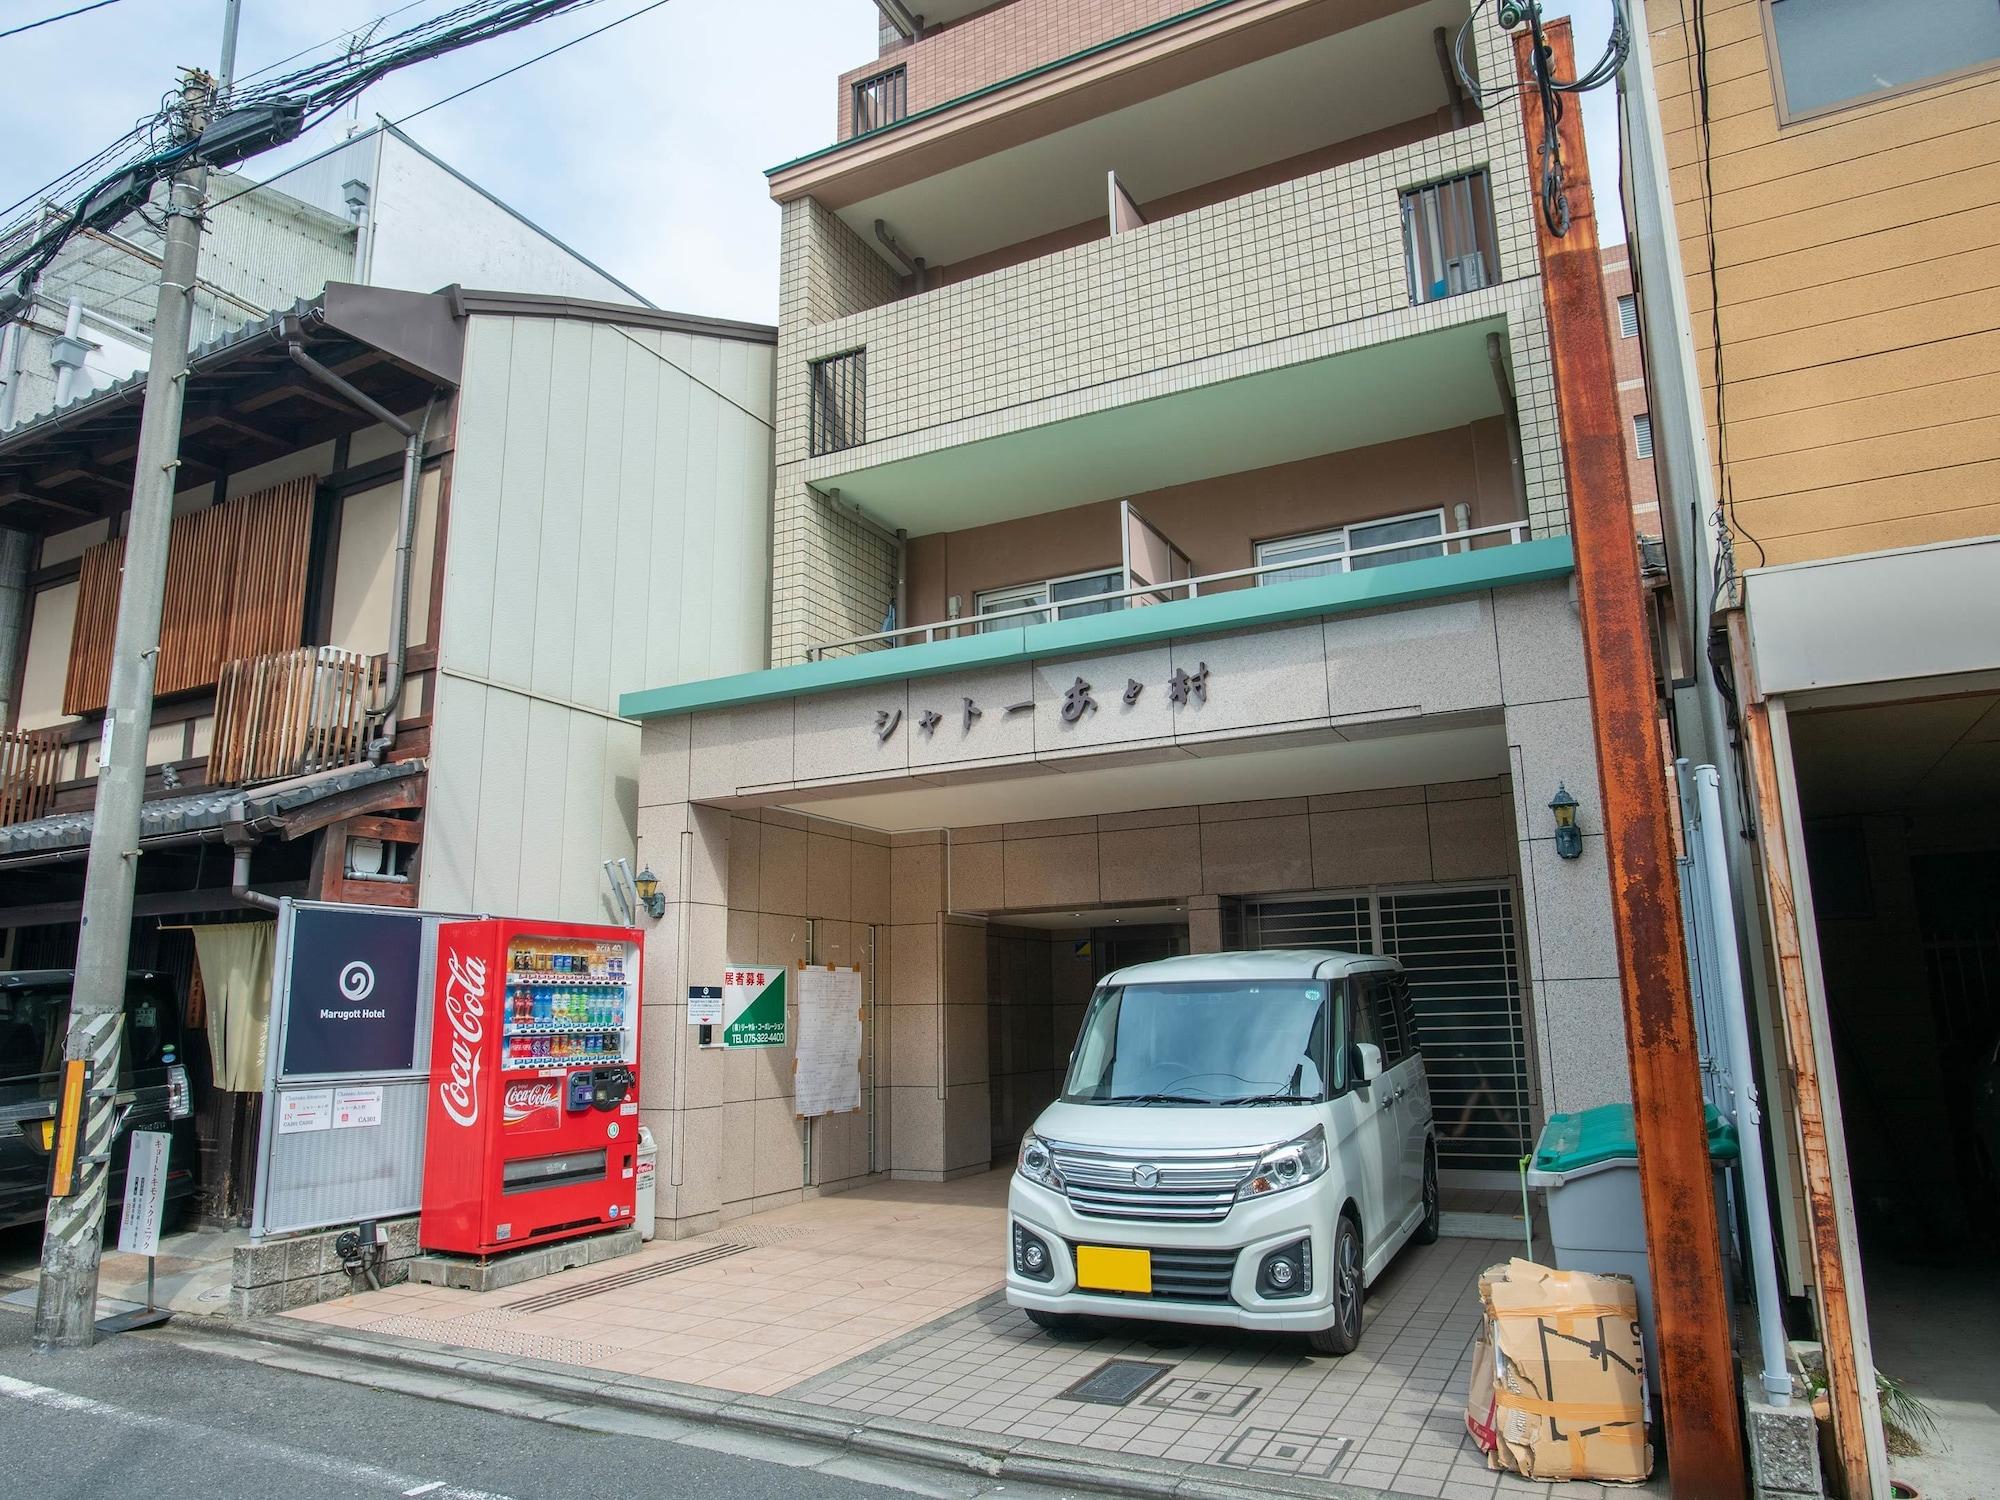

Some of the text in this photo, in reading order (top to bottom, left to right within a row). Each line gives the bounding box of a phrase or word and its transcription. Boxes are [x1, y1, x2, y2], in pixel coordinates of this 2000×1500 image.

[320, 1009, 385, 1020] Marugott Hotel
[440, 946, 487, 1127] Coca-Cola
[732, 1032, 784, 1044] TEL 075-322-4400
[505, 1083, 553, 1108] Coca-Cola
